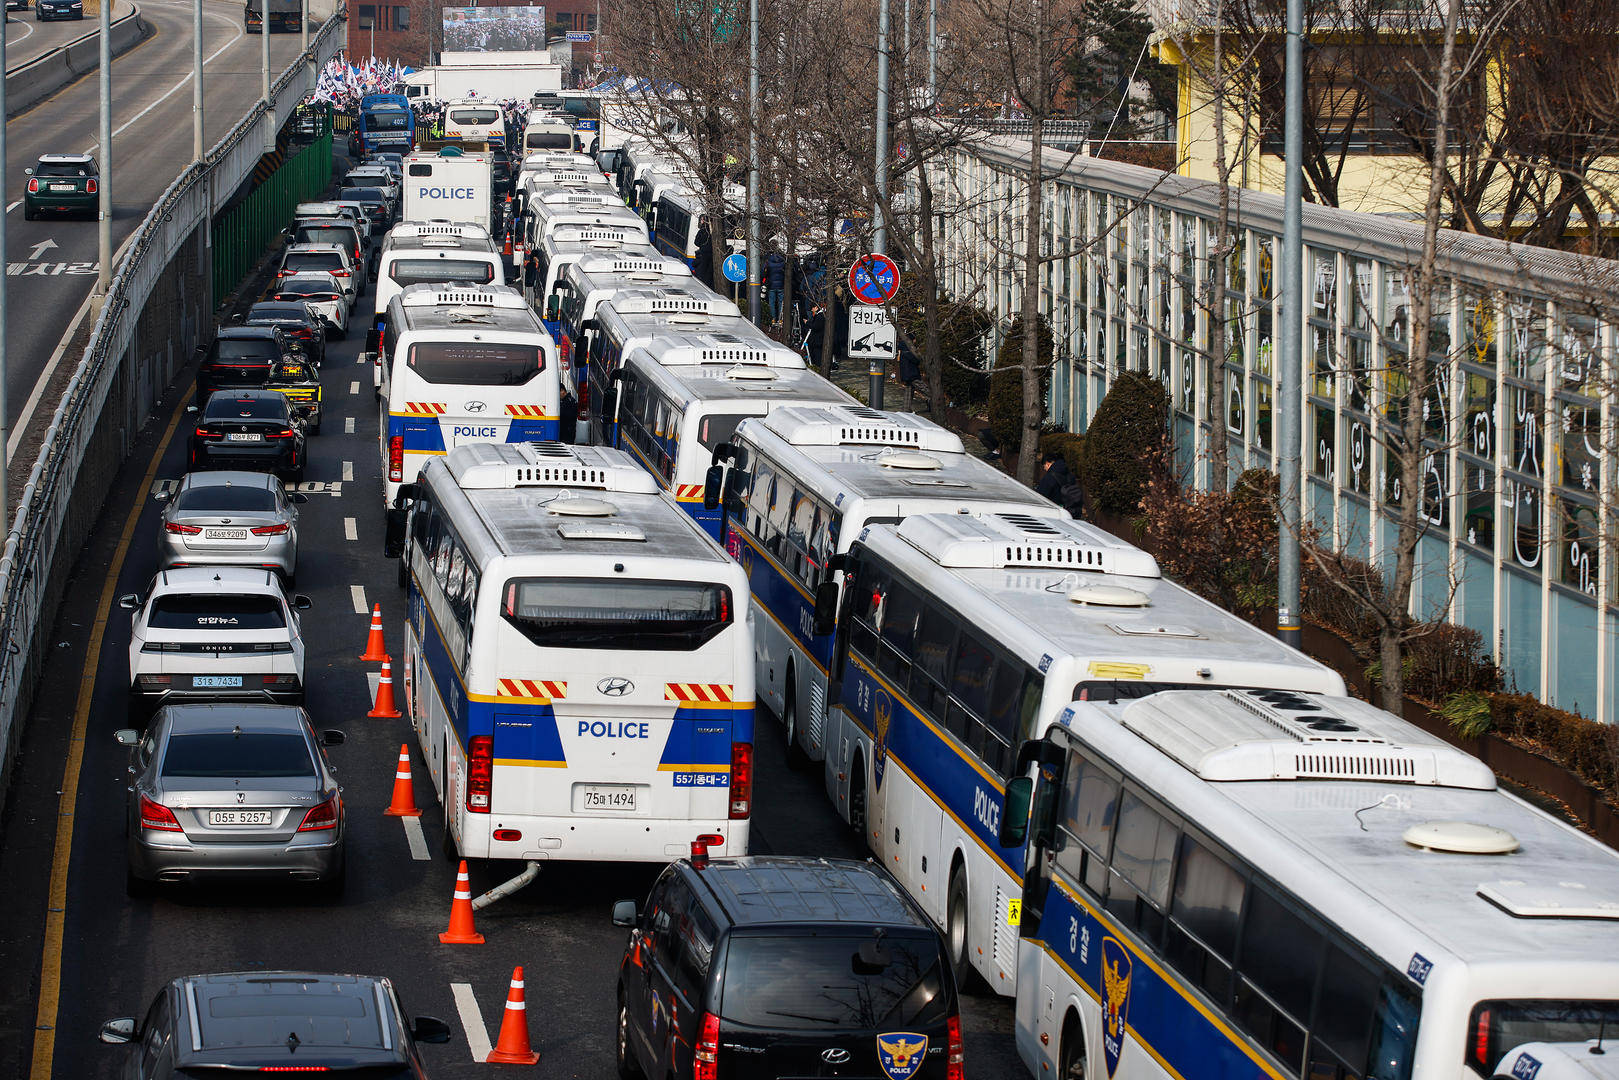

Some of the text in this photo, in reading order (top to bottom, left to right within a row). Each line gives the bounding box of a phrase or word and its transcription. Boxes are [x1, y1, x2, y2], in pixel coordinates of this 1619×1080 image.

[420, 188, 475, 200] POLICE
[856, 273, 893, 284] 주정금지
[454, 426, 497, 438] POLICE
[197, 617, 239, 625] 연합뉴스
[218, 677, 238, 686] 7434
[578, 720, 649, 739] POLICE
[676, 774, 728, 786] 55기동대-2
[586, 792, 634, 806] 75마 1494
[974, 785, 1000, 837] POLICE
[240, 812, 266, 823] 5257
[1069, 915, 1090, 965] 경찰
